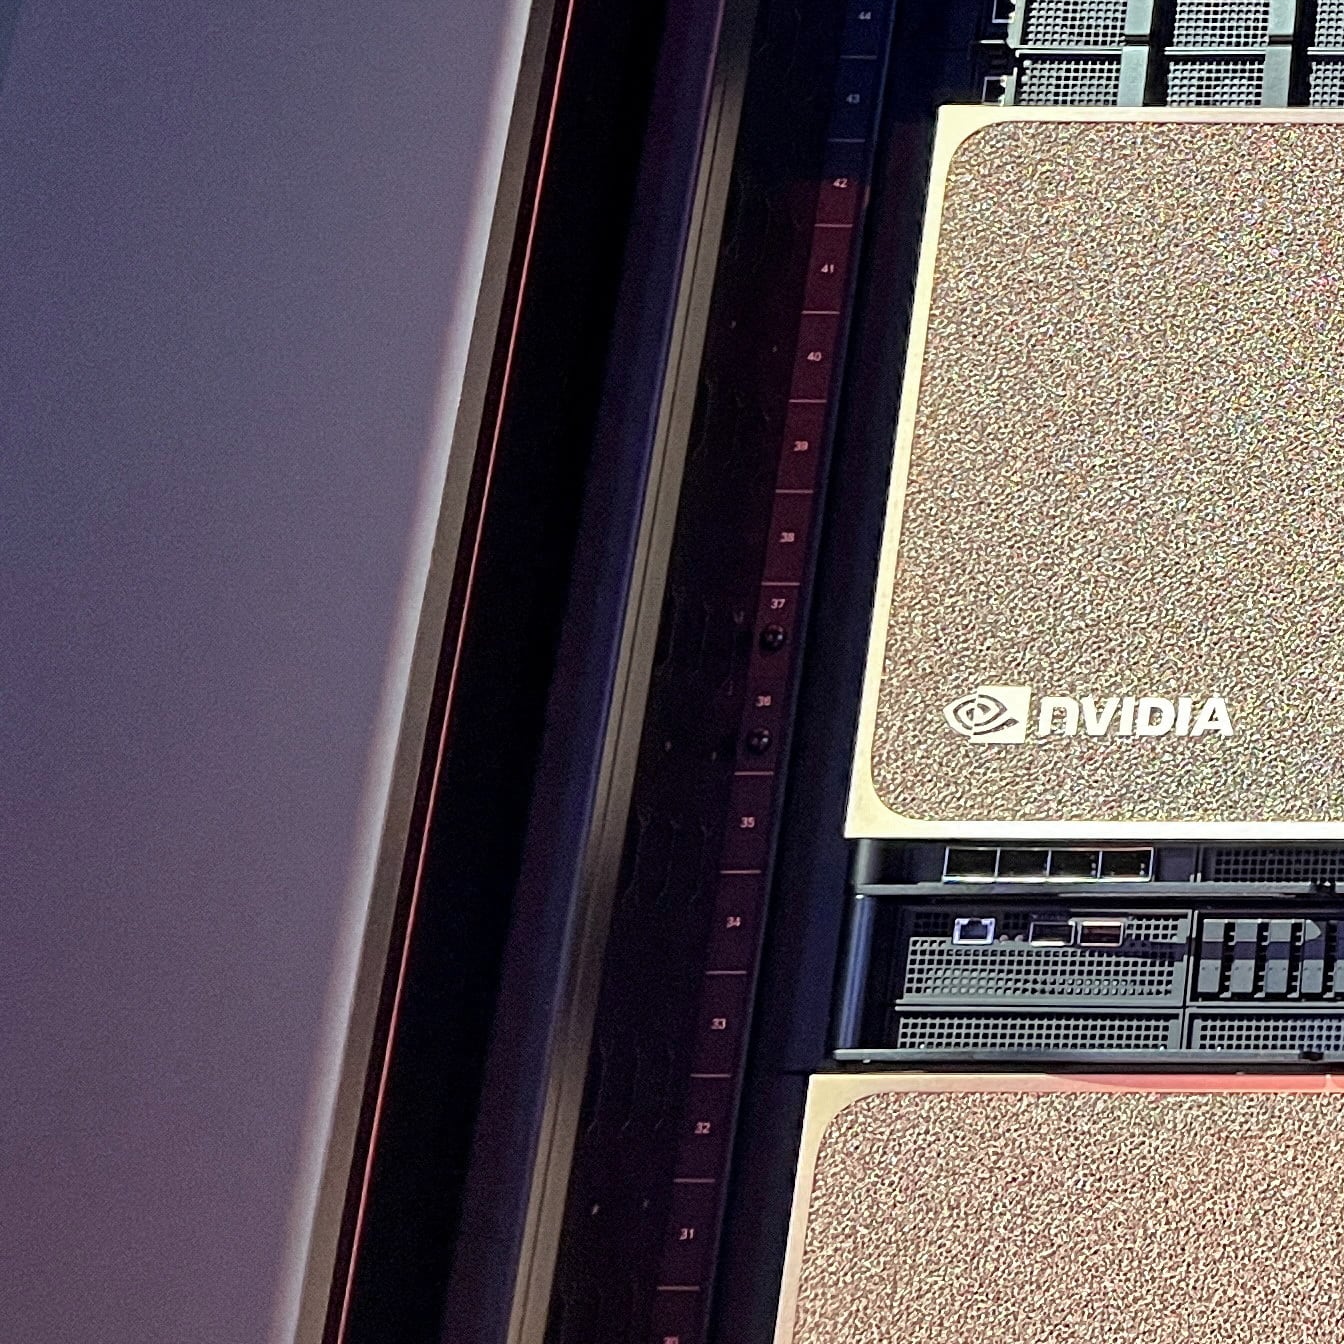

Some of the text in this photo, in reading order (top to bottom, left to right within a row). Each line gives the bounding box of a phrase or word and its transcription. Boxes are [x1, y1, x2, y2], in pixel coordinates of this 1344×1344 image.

[858, 11, 872, 20] 44
[846, 93, 860, 104] 43
[833, 178, 848, 188] 42
[820, 264, 835, 273] 41
[807, 351, 822, 362] 40
[770, 598, 786, 609] 37
[1038, 695, 1235, 736] NVIDIA
[740, 816, 755, 828] 35
[726, 916, 741, 928] 34
[694, 1121, 711, 1134] 32
[679, 1228, 695, 1240] 31
